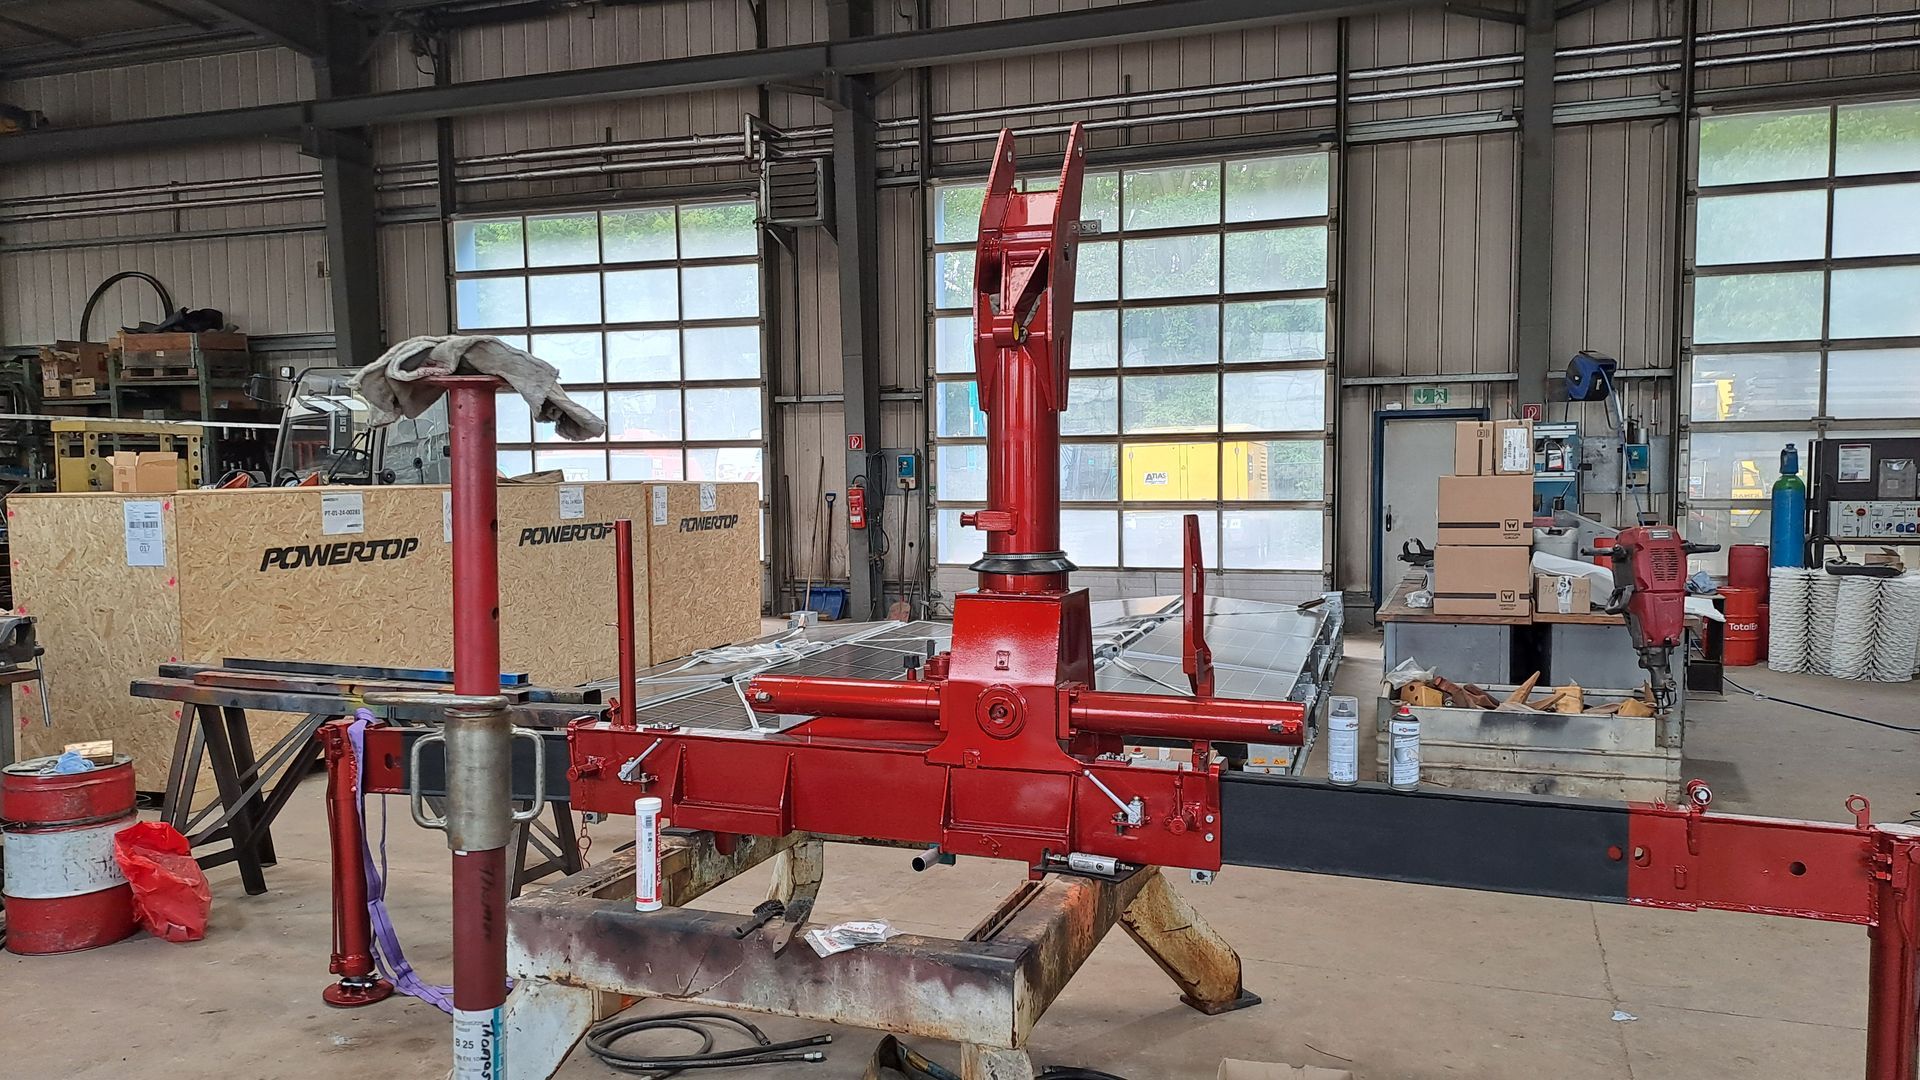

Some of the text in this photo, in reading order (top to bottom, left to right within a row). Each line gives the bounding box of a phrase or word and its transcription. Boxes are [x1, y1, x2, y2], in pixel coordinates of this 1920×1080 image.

[518, 522, 614, 547] POWERTOP
[679, 514, 739, 533] POWERTOP
[259, 537, 419, 572] POWERTOP
[462, 1040, 475, 1049] 25
